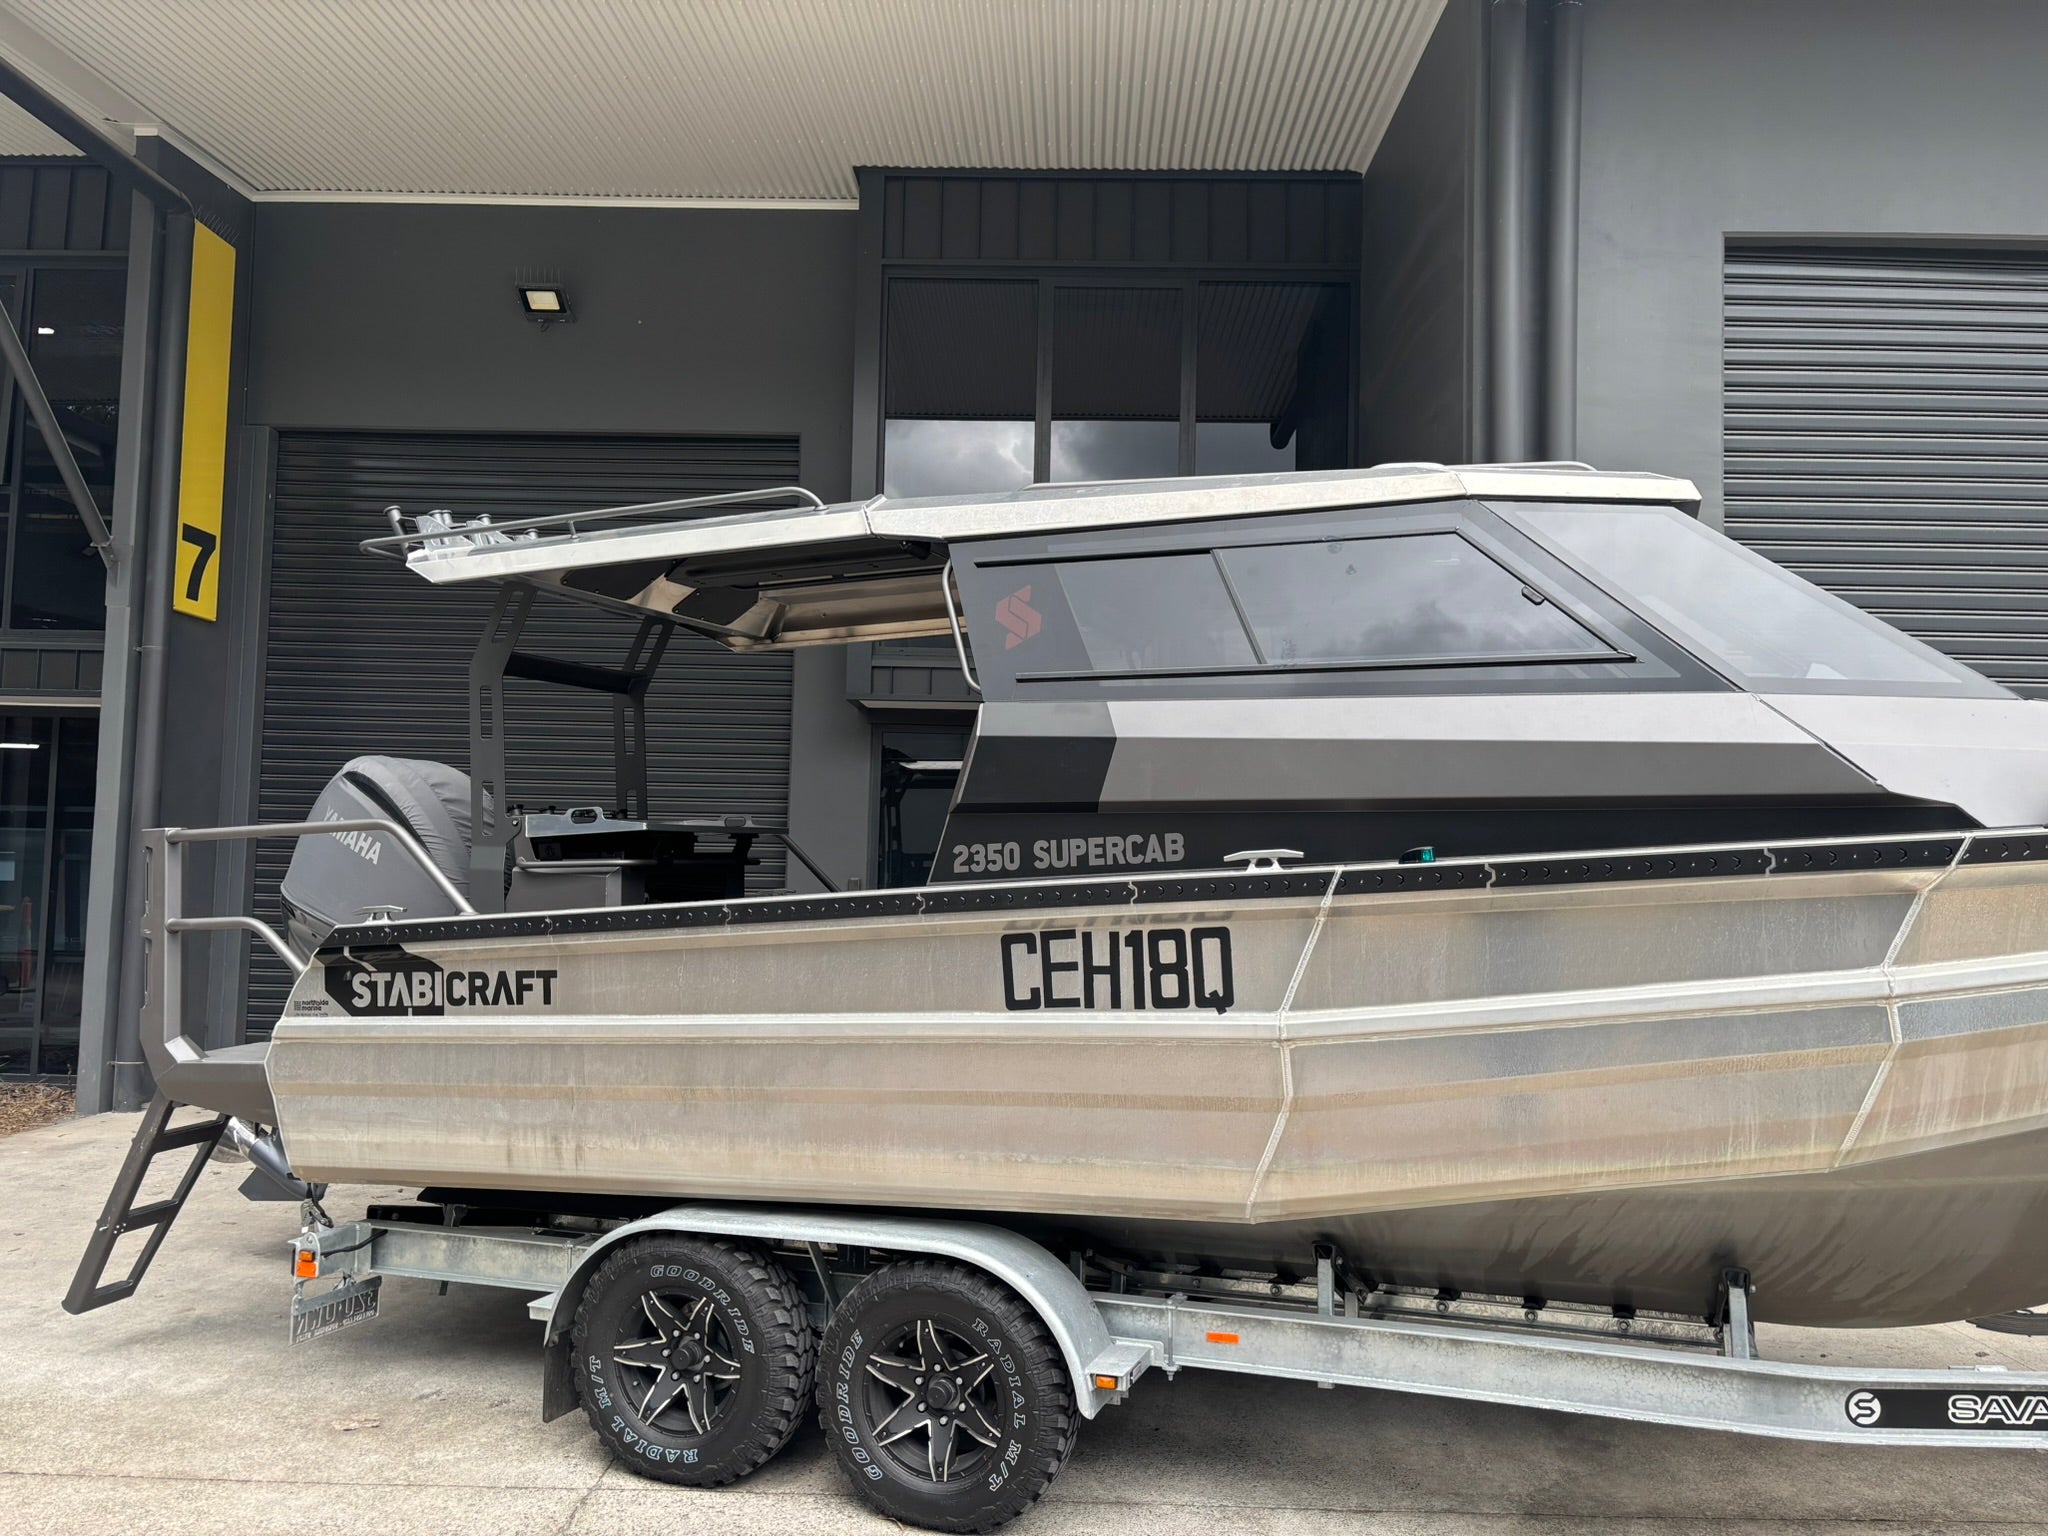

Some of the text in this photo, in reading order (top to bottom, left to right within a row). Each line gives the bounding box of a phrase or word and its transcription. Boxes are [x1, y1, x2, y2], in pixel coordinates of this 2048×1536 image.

[181, 522, 217, 602] 7
[952, 833, 1185, 873] 2350 SUPERCAB
[351, 969, 558, 1008] STABICRAFT
[1000, 926, 1235, 1015] CEH18Q
[650, 1264, 755, 1354] GOODRIDE
[588, 1355, 699, 1464] RADIAL M/T
[836, 1329, 883, 1481] GOODRIDE
[972, 1317, 1026, 1491] RADIAL M/T
